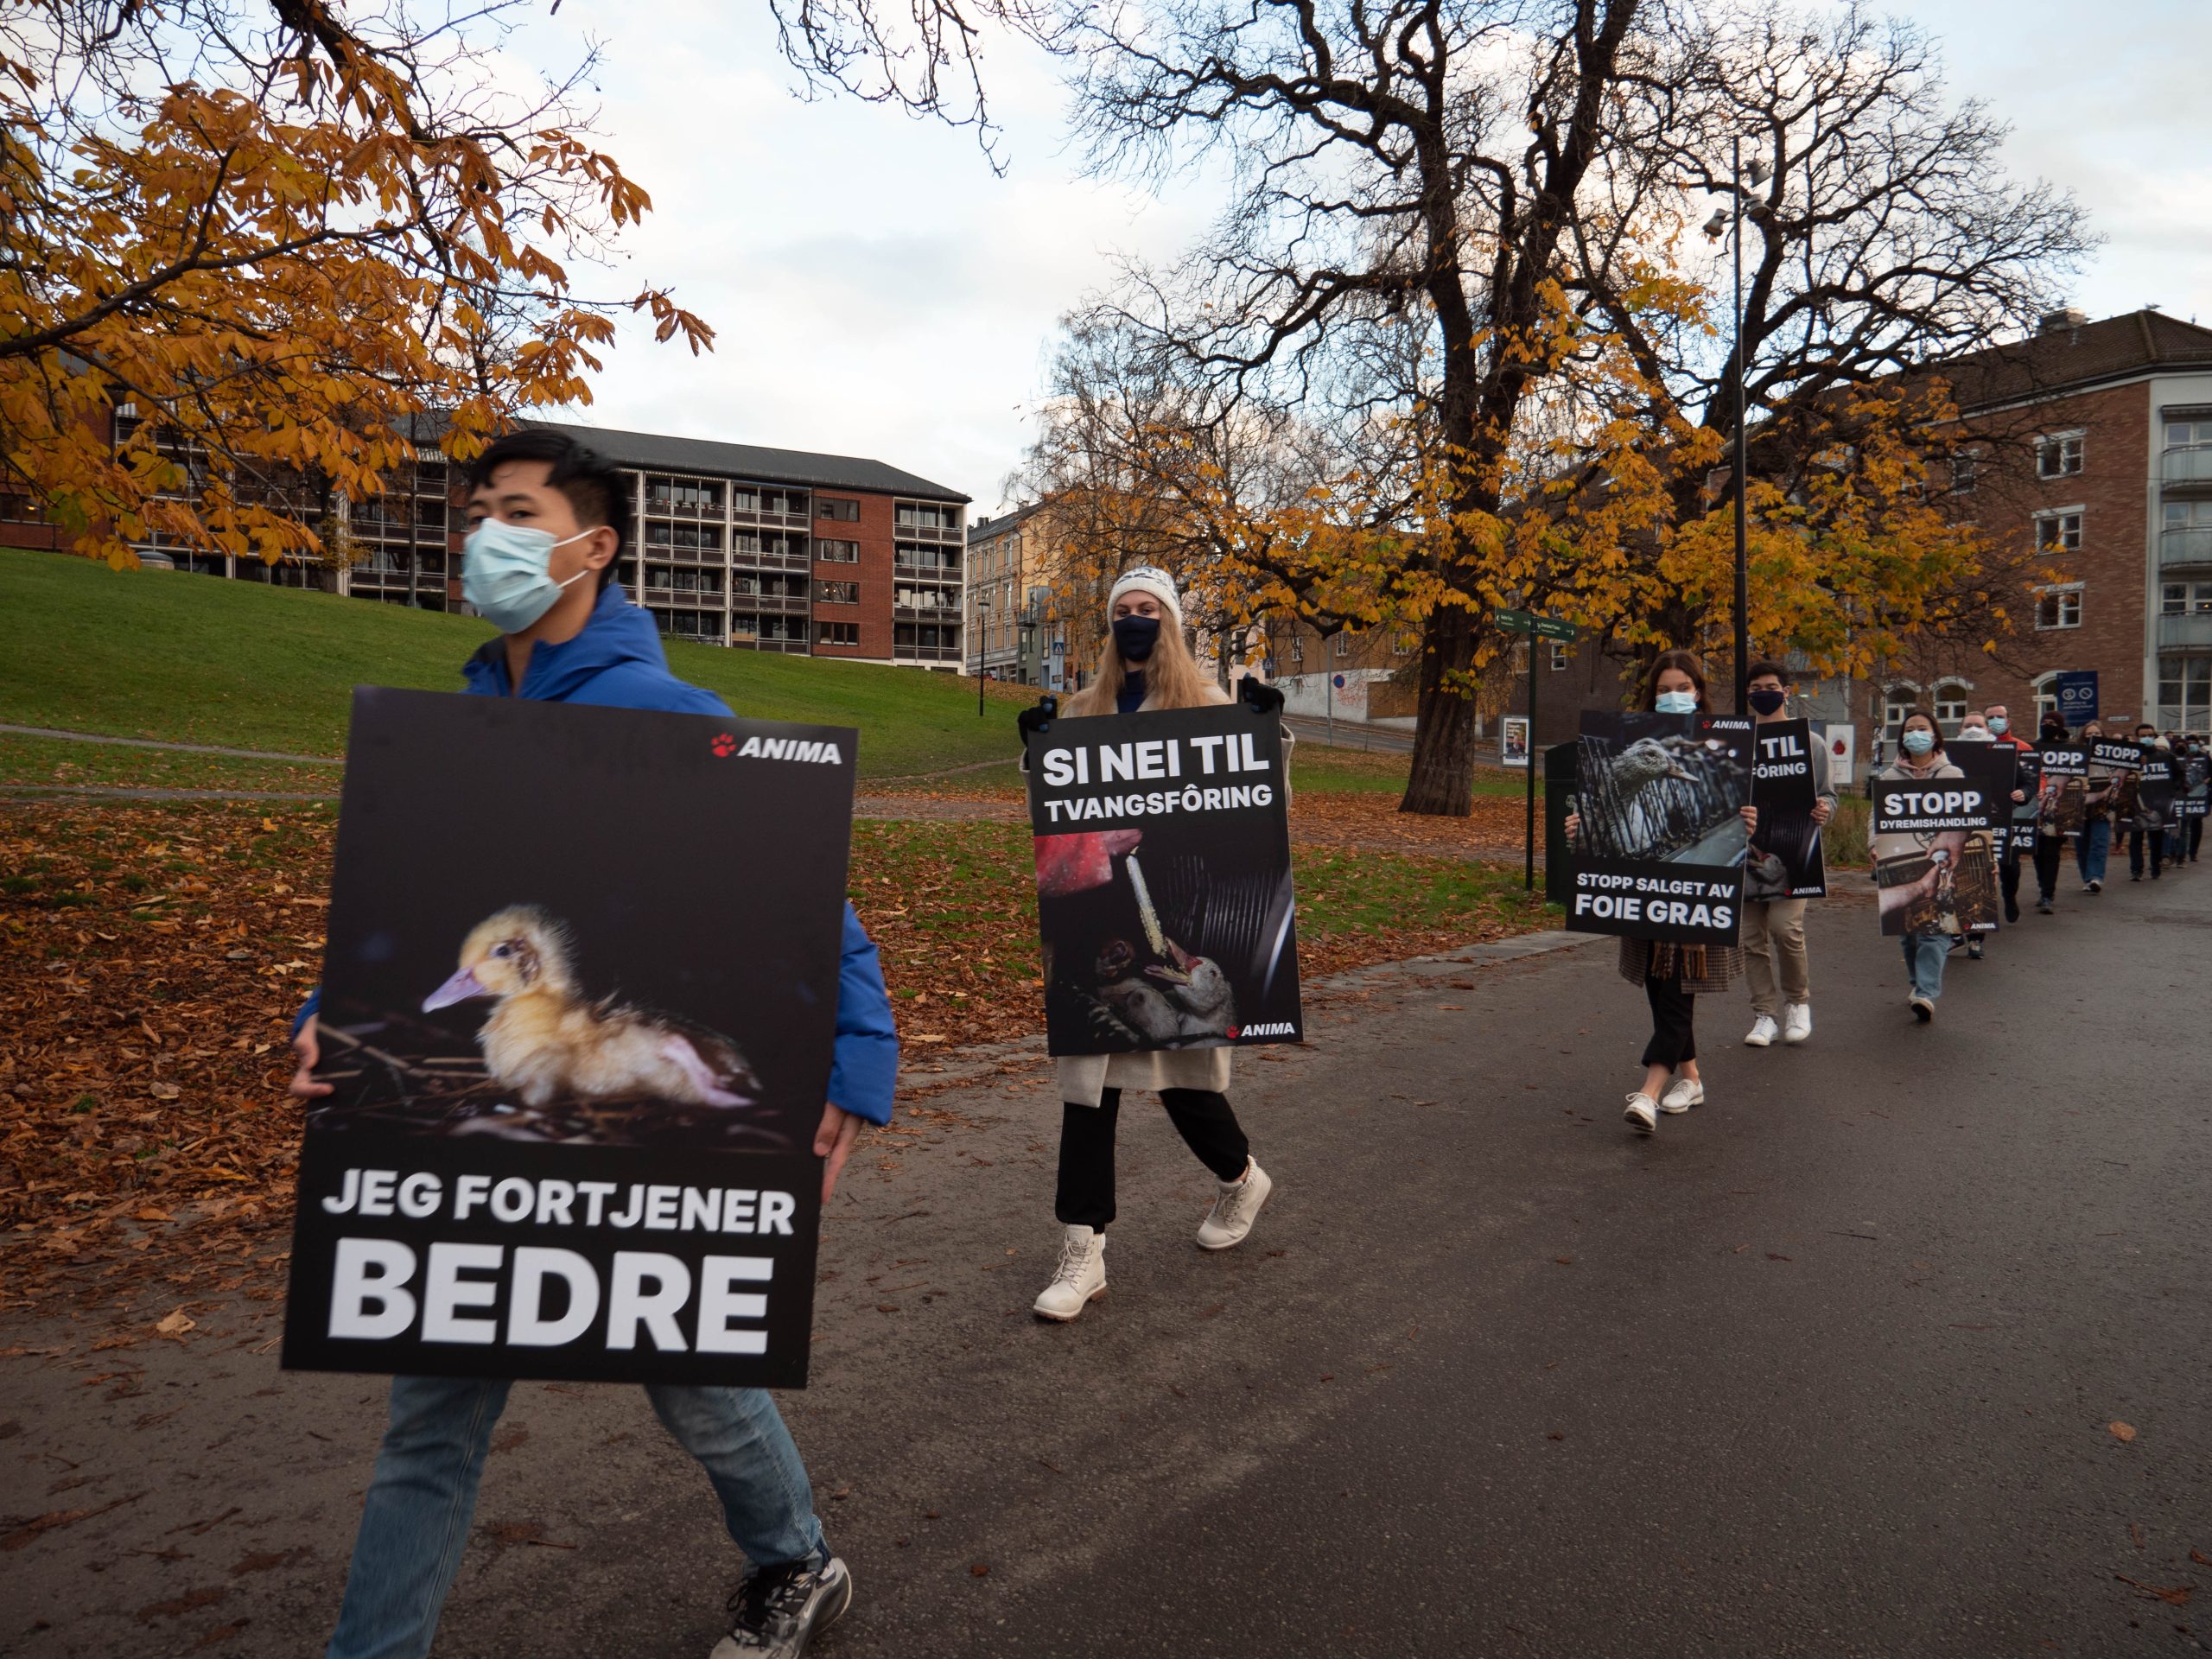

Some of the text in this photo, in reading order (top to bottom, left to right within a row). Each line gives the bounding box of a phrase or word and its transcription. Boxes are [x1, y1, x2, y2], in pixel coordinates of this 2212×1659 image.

[1713, 721, 1750, 729] ANIMA
[738, 737, 842, 764] ANIMA
[1761, 736, 1804, 758] TIL
[2094, 744, 2140, 760] STOPP
[1044, 734, 1269, 785] SI NEI TIL
[1044, 783, 1273, 823] TVANGSFÔRING
[1885, 791, 1980, 815] STOPP
[1880, 817, 1987, 831] DYREMISHANDLING
[1577, 874, 1734, 898] STOPP SALGET AV
[1576, 894, 1732, 928] FOIE GRAS
[1241, 1023, 1294, 1036] ANIMA
[323, 1169, 795, 1234] JEG FORTJENER
[329, 1238, 773, 1353] BEDRE
